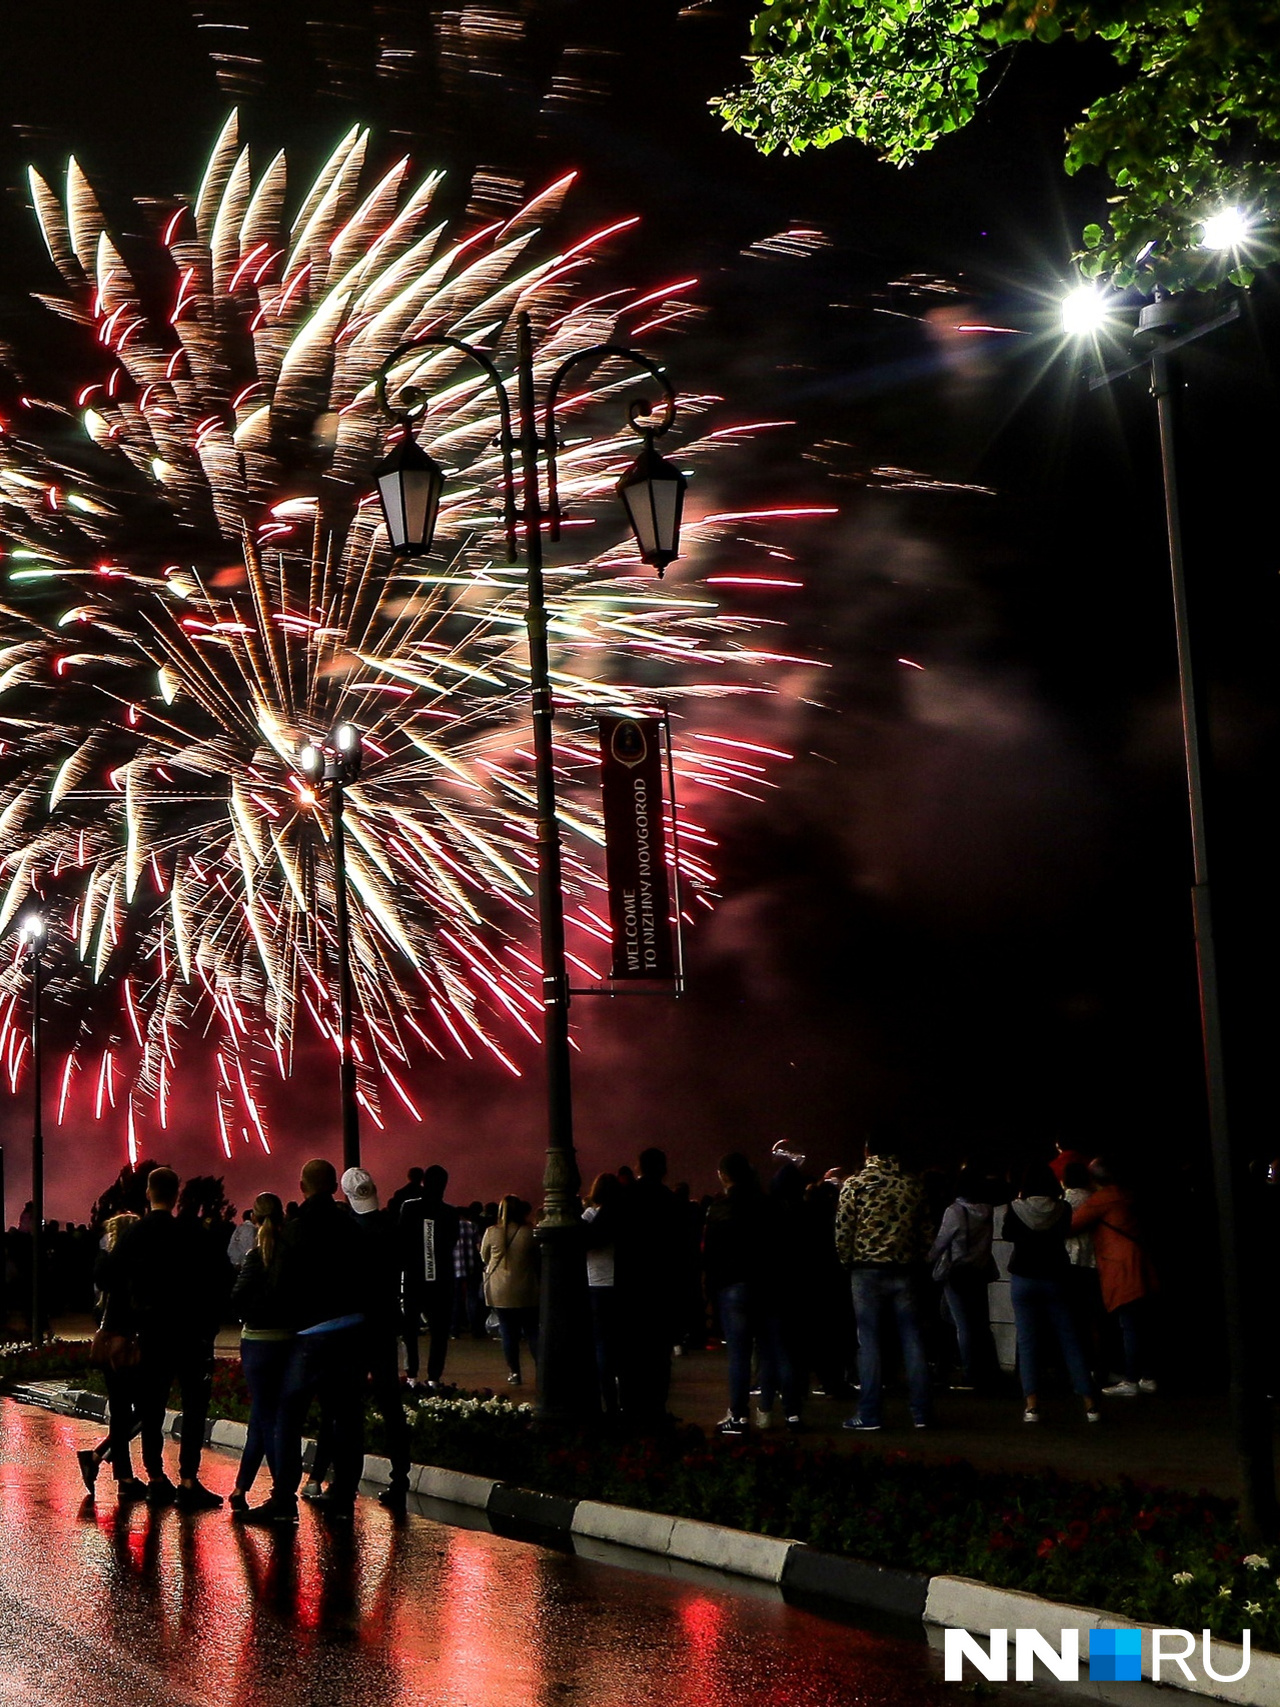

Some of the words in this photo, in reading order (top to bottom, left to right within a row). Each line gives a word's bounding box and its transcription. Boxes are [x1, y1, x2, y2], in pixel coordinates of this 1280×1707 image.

[633, 778, 651, 876] NOVGOROD
[623, 888, 640, 971] WELCOME
[639, 880, 656, 944] NIZHNY
[644, 949, 657, 970] TO
